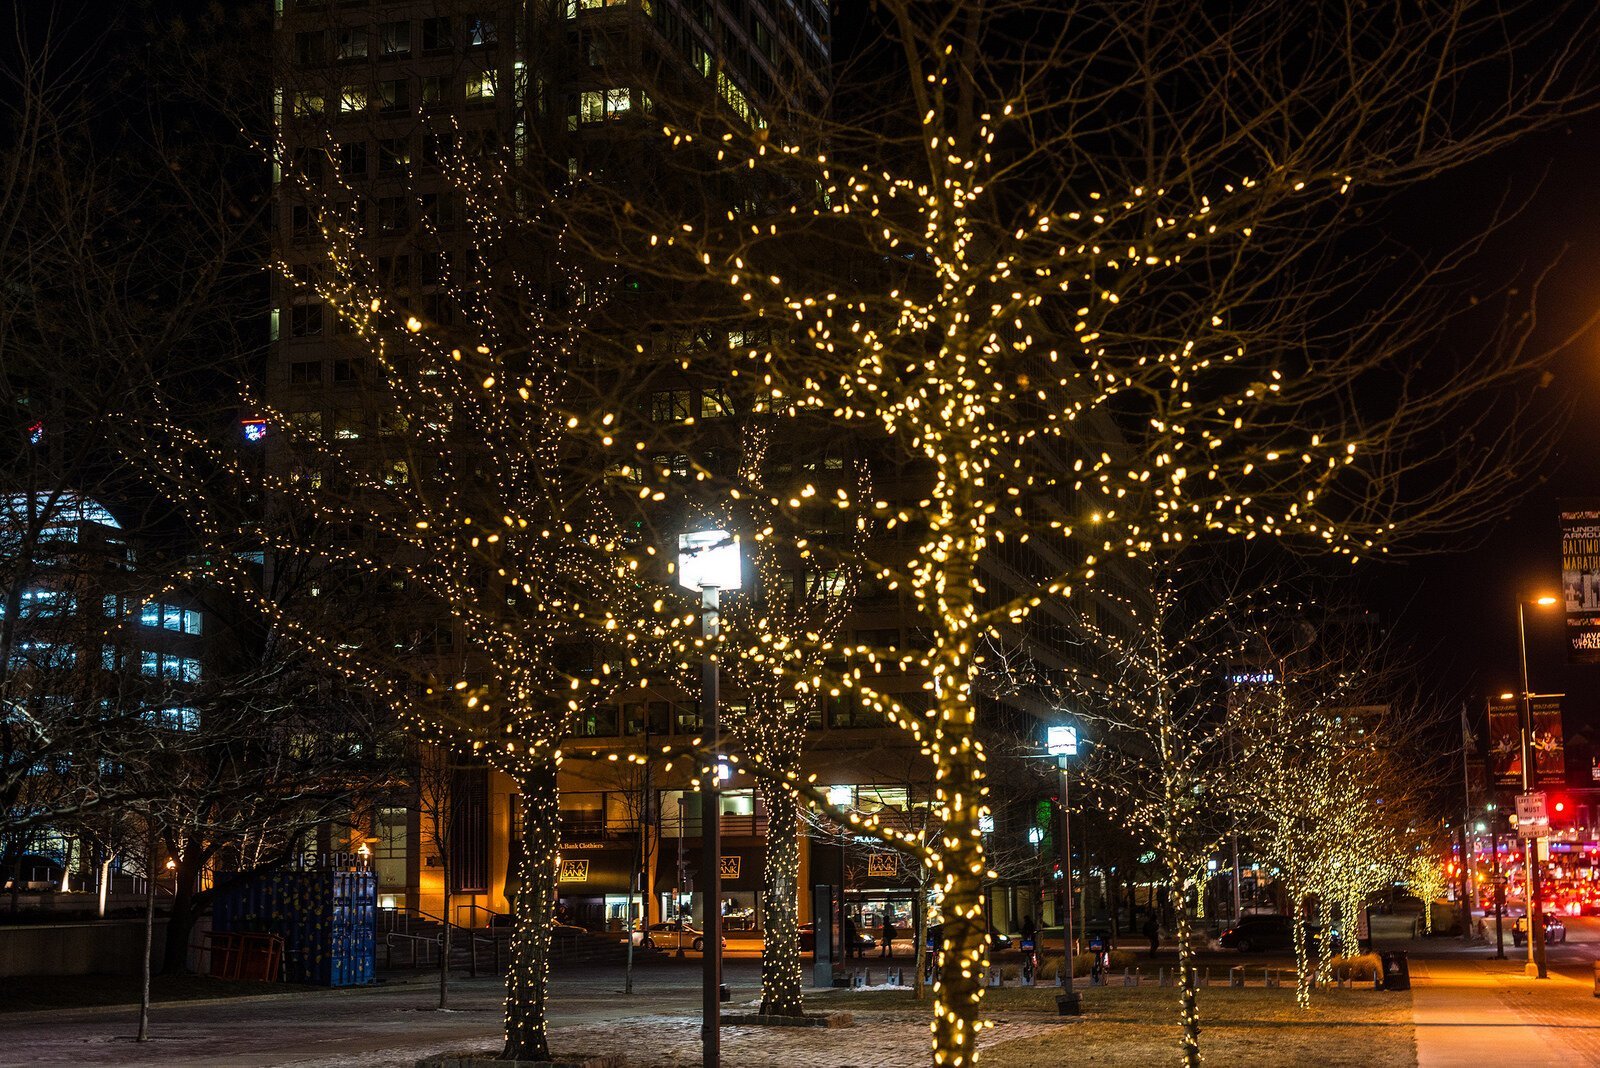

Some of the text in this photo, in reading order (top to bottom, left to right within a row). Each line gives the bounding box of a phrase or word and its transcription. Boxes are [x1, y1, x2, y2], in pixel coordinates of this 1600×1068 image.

[1563, 538, 1600, 555] BALTIMO
[1563, 555, 1600, 570] MARATH
[562, 869, 586, 877] BANK
